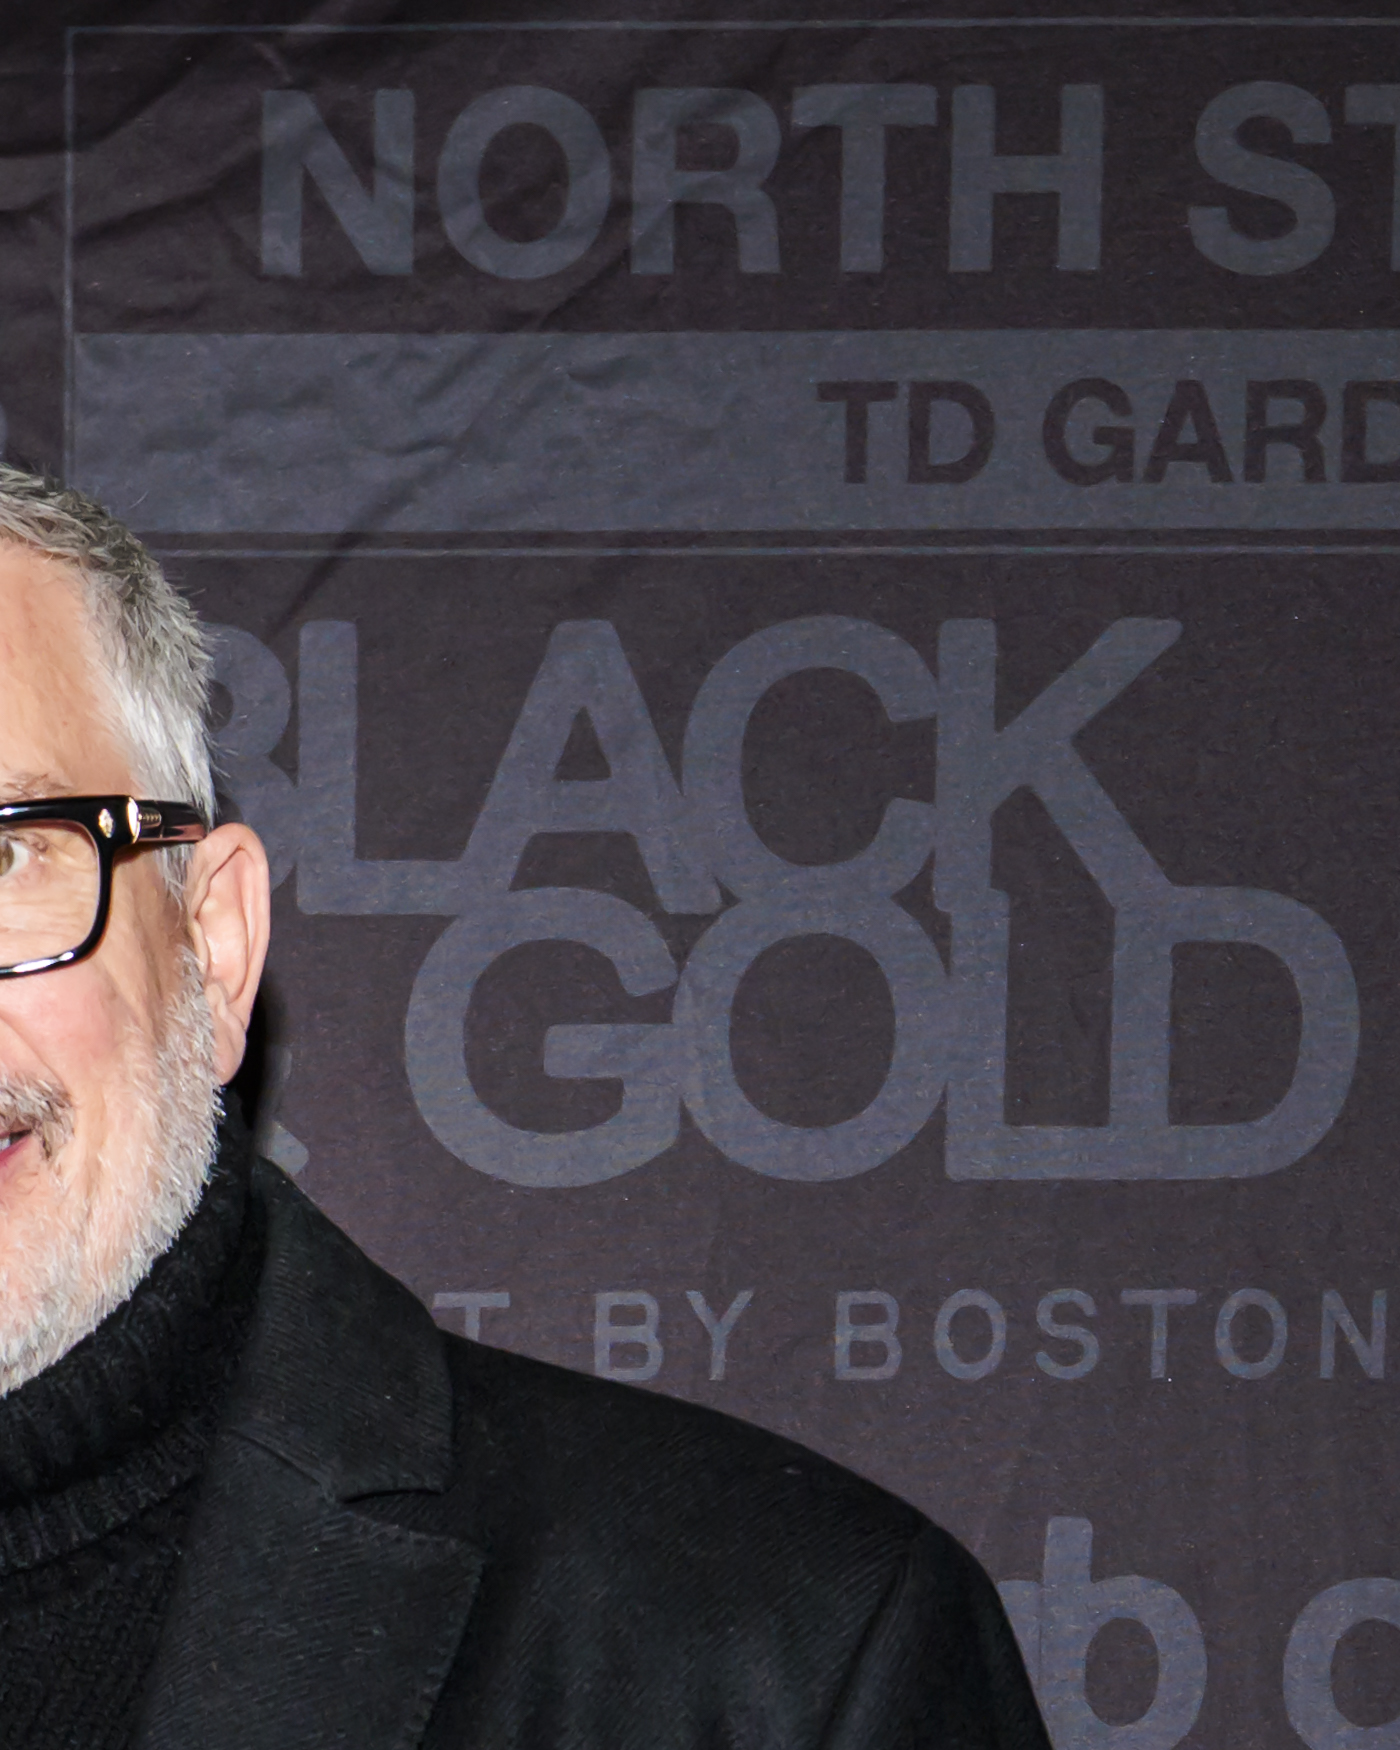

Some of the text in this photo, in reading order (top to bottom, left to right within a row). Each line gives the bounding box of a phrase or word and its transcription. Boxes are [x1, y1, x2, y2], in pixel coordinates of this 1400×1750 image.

[258, 82, 1106, 281] NORTH
[815, 376, 1400, 487] TD GARD
[405, 883, 1362, 1189] GOLD
[594, 1289, 756, 1382] BY
[834, 1286, 1388, 1382] BOSTON
